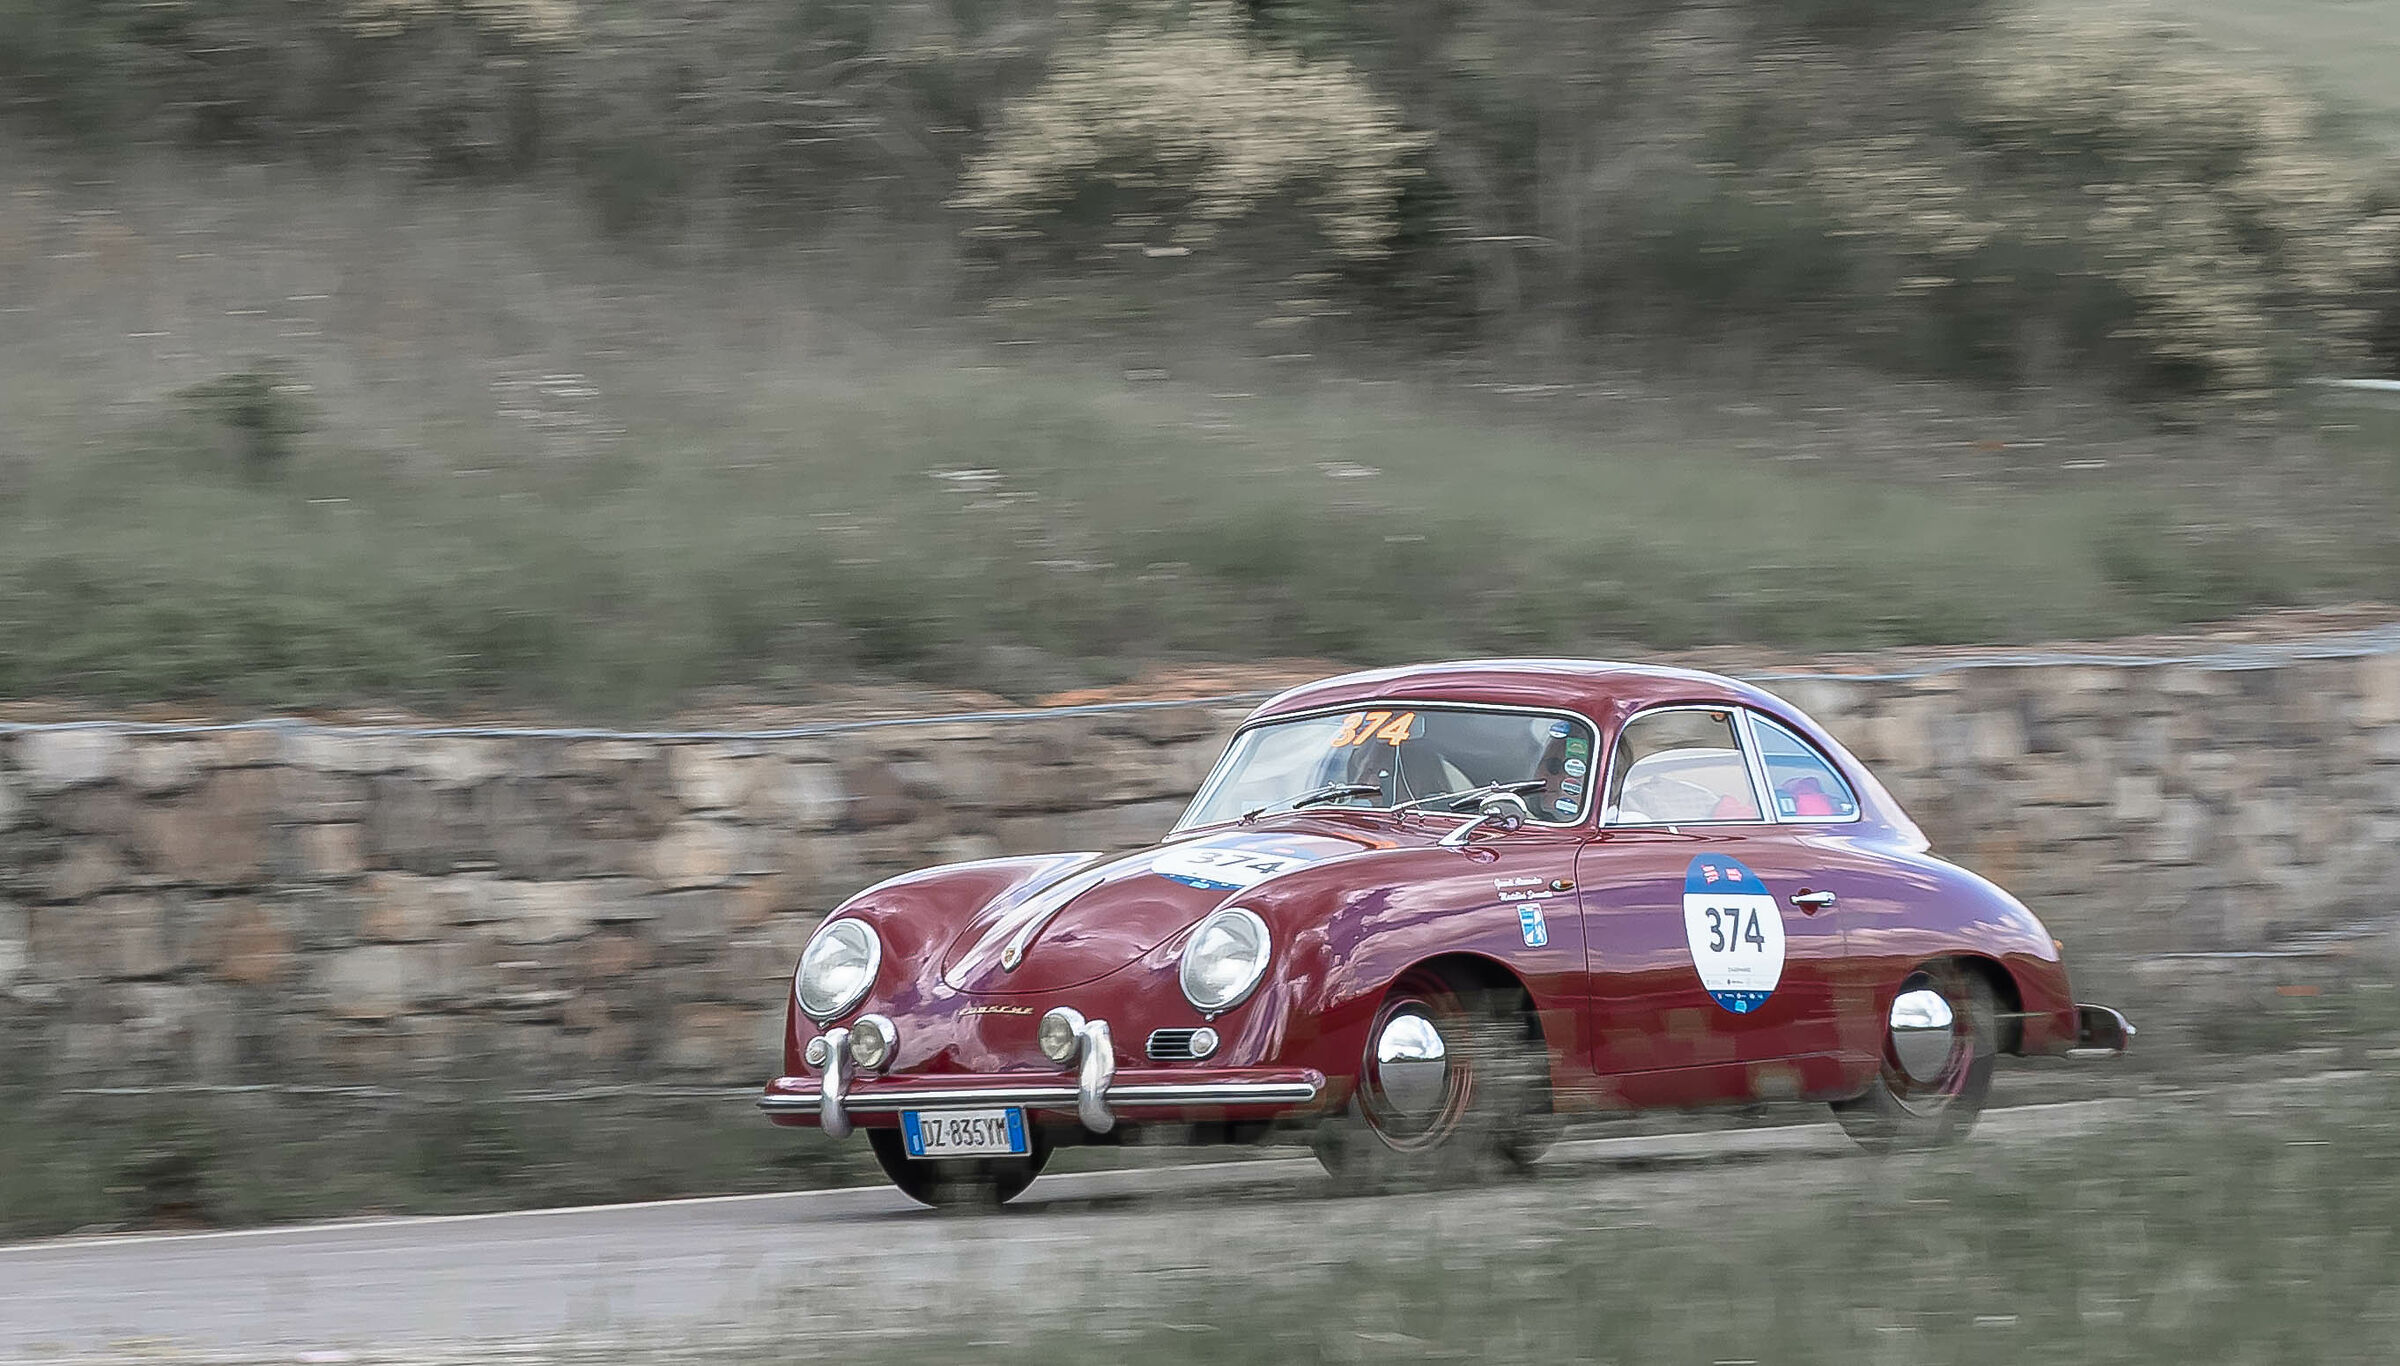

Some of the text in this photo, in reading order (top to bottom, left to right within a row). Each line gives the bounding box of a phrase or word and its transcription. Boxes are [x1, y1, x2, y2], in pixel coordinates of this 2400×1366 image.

[1331, 711, 1416, 748] 374
[1187, 851, 1286, 875] 374
[1705, 907, 1765, 953] 374
[920, 1119, 946, 1147] DZ
